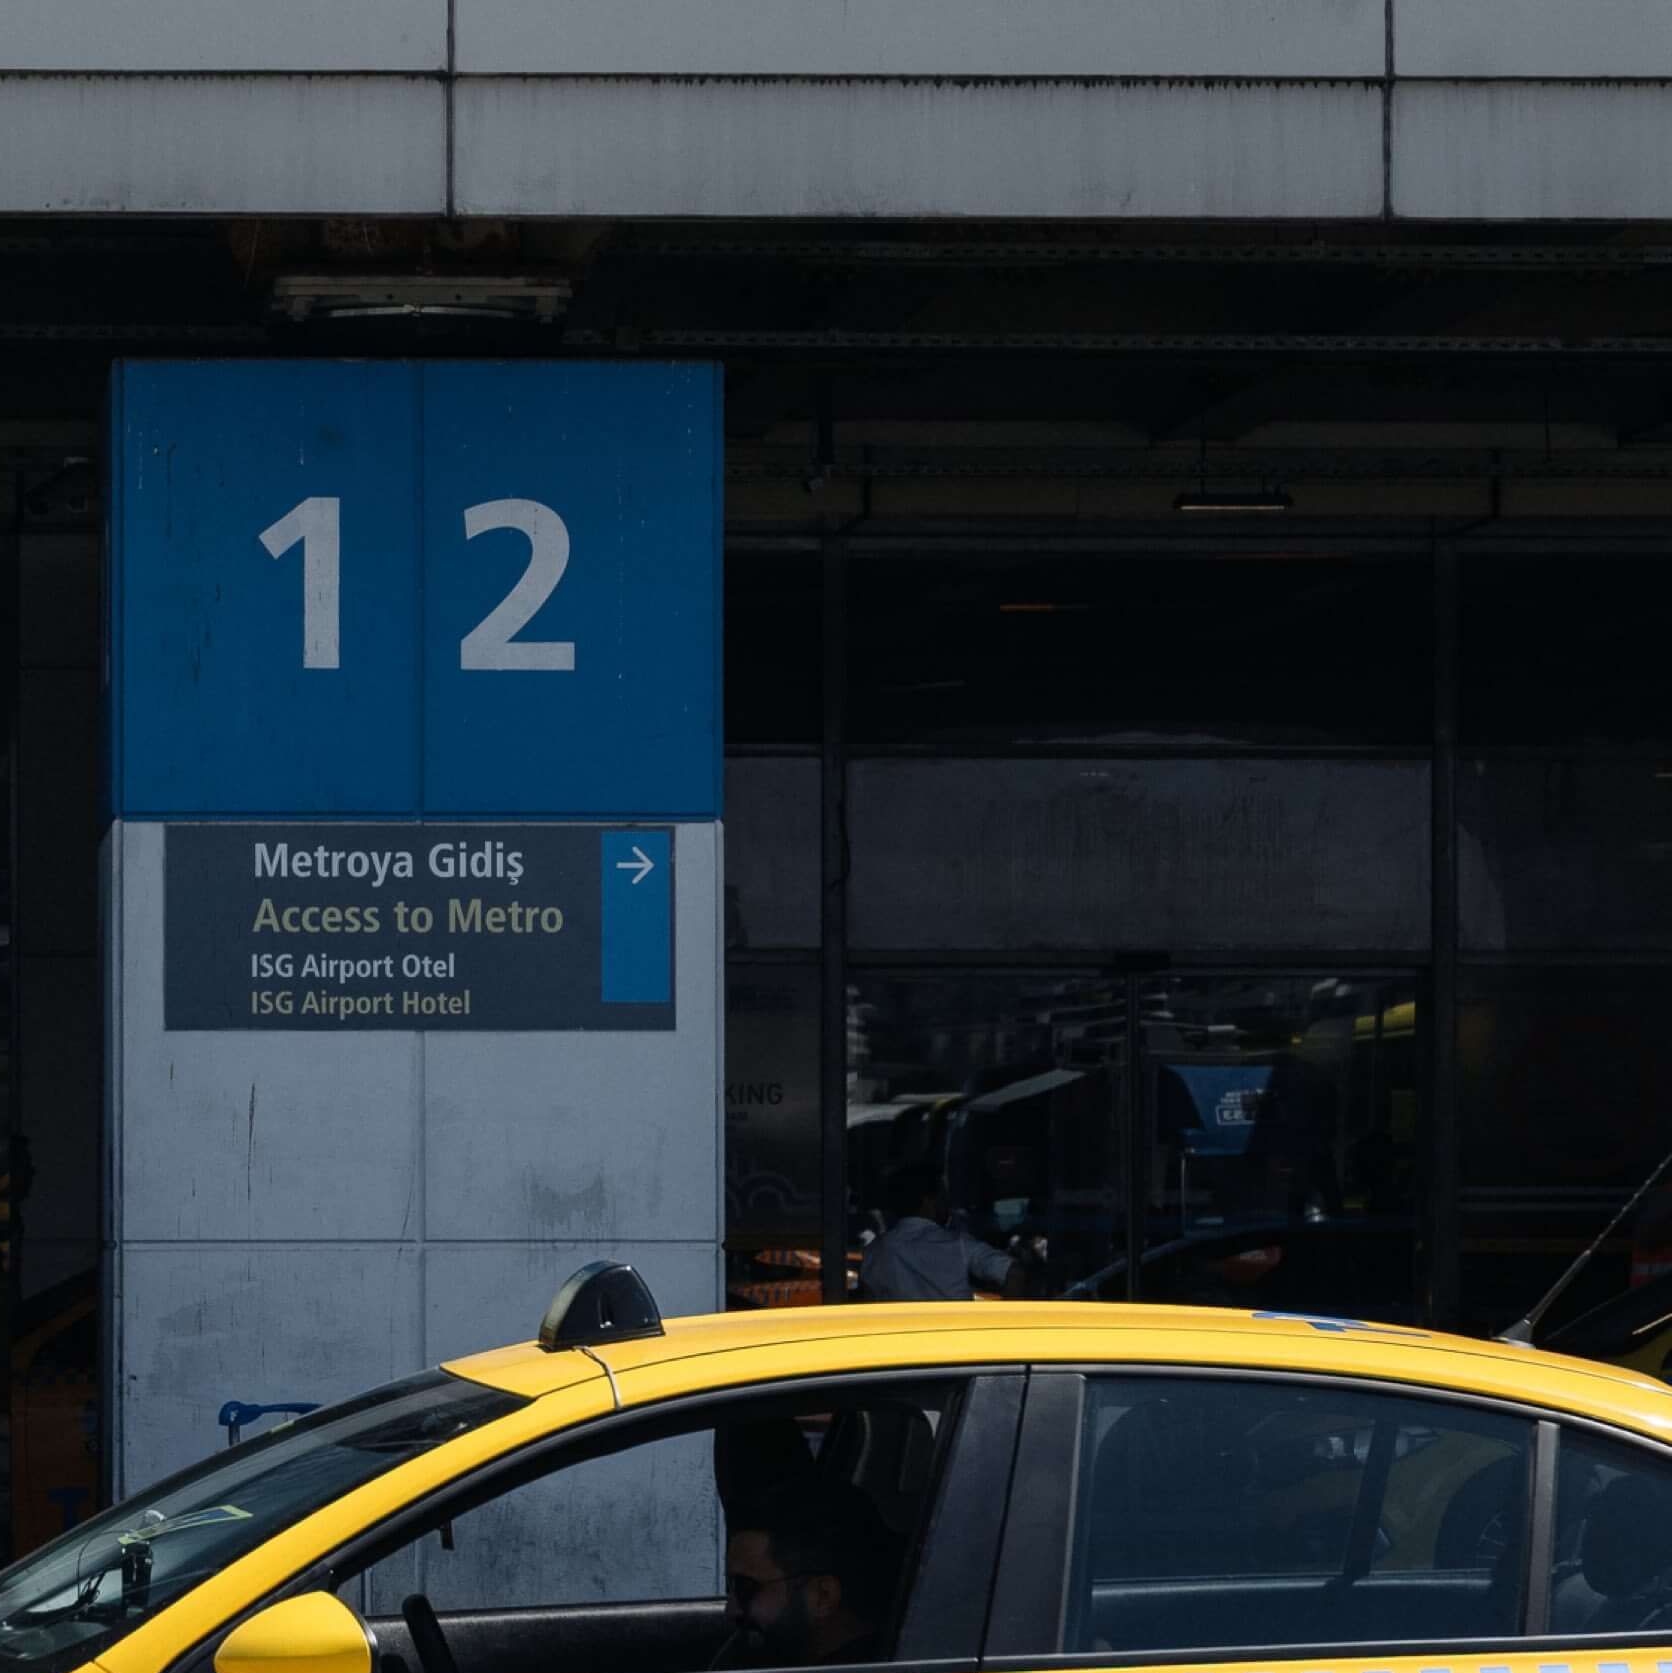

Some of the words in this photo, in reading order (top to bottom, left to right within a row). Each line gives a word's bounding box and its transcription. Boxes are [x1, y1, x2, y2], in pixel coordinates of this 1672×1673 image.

[258, 497, 339, 668] 1
[461, 498, 575, 670] 2
[254, 842, 414, 887] Metroya
[428, 841, 525, 886] Gidiş
[252, 898, 381, 934] Access
[393, 901, 434, 934] to
[448, 898, 564, 934] Metro
[251, 954, 294, 978] ISG
[300, 953, 394, 984] Airport
[401, 953, 456, 978] Otel
[251, 991, 294, 1015] ISG
[300, 990, 394, 1020] Airport
[402, 989, 471, 1015] Hotel
